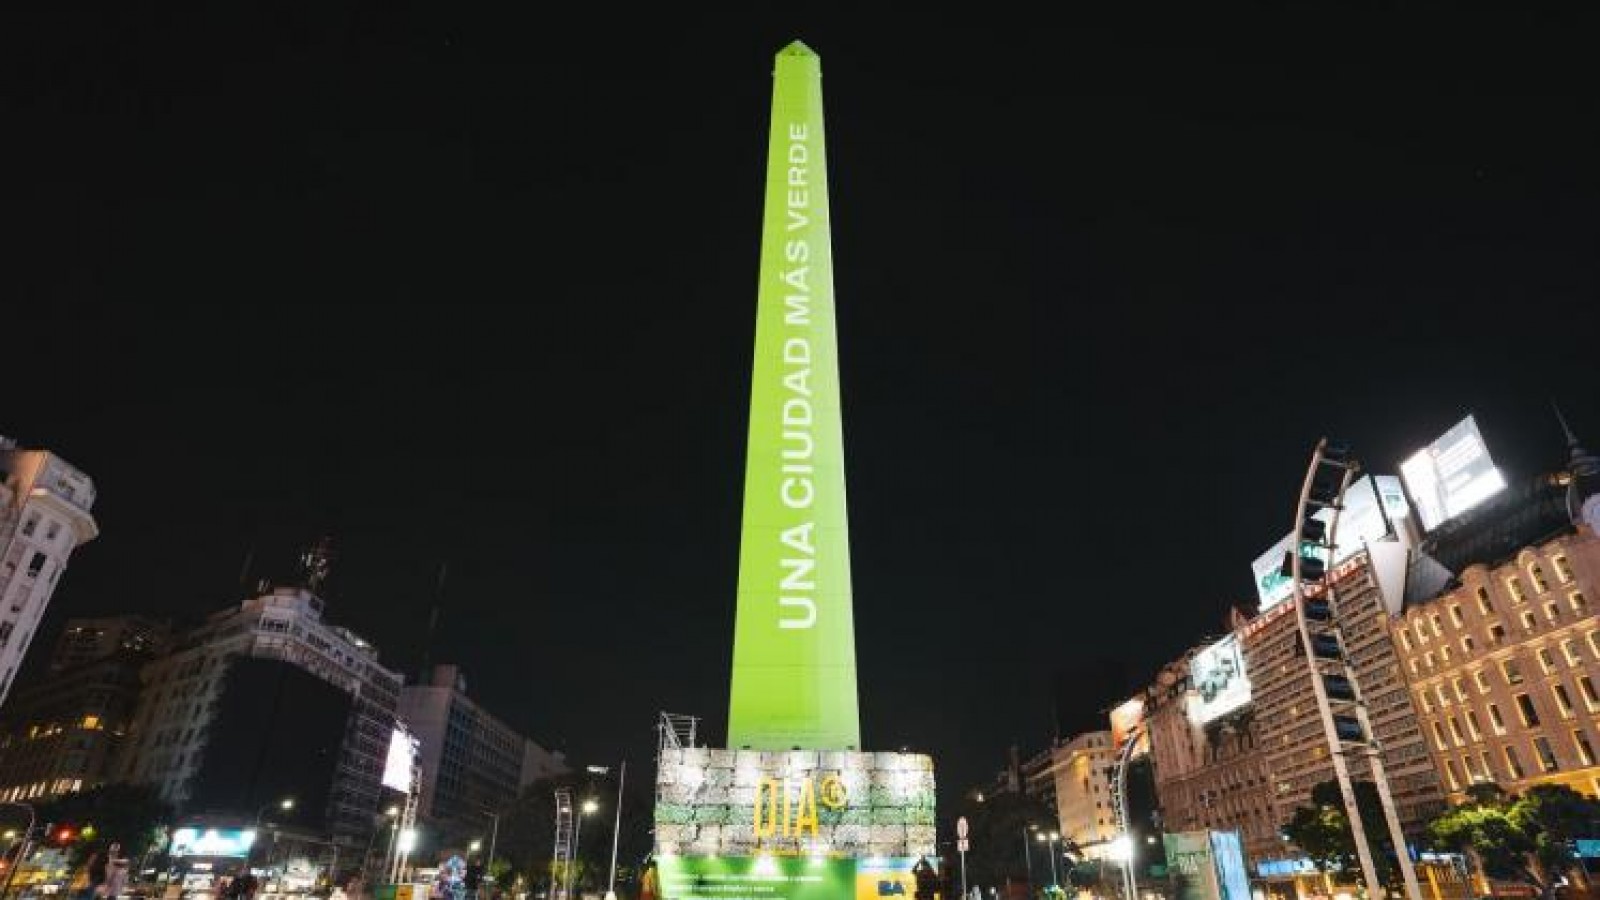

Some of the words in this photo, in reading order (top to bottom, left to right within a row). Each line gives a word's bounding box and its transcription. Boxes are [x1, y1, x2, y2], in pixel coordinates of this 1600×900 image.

[788, 123, 808, 232] VERDE
[780, 239, 810, 325] MÁS
[781, 338, 815, 508] CIUDAD
[778, 522, 817, 628] UNA
